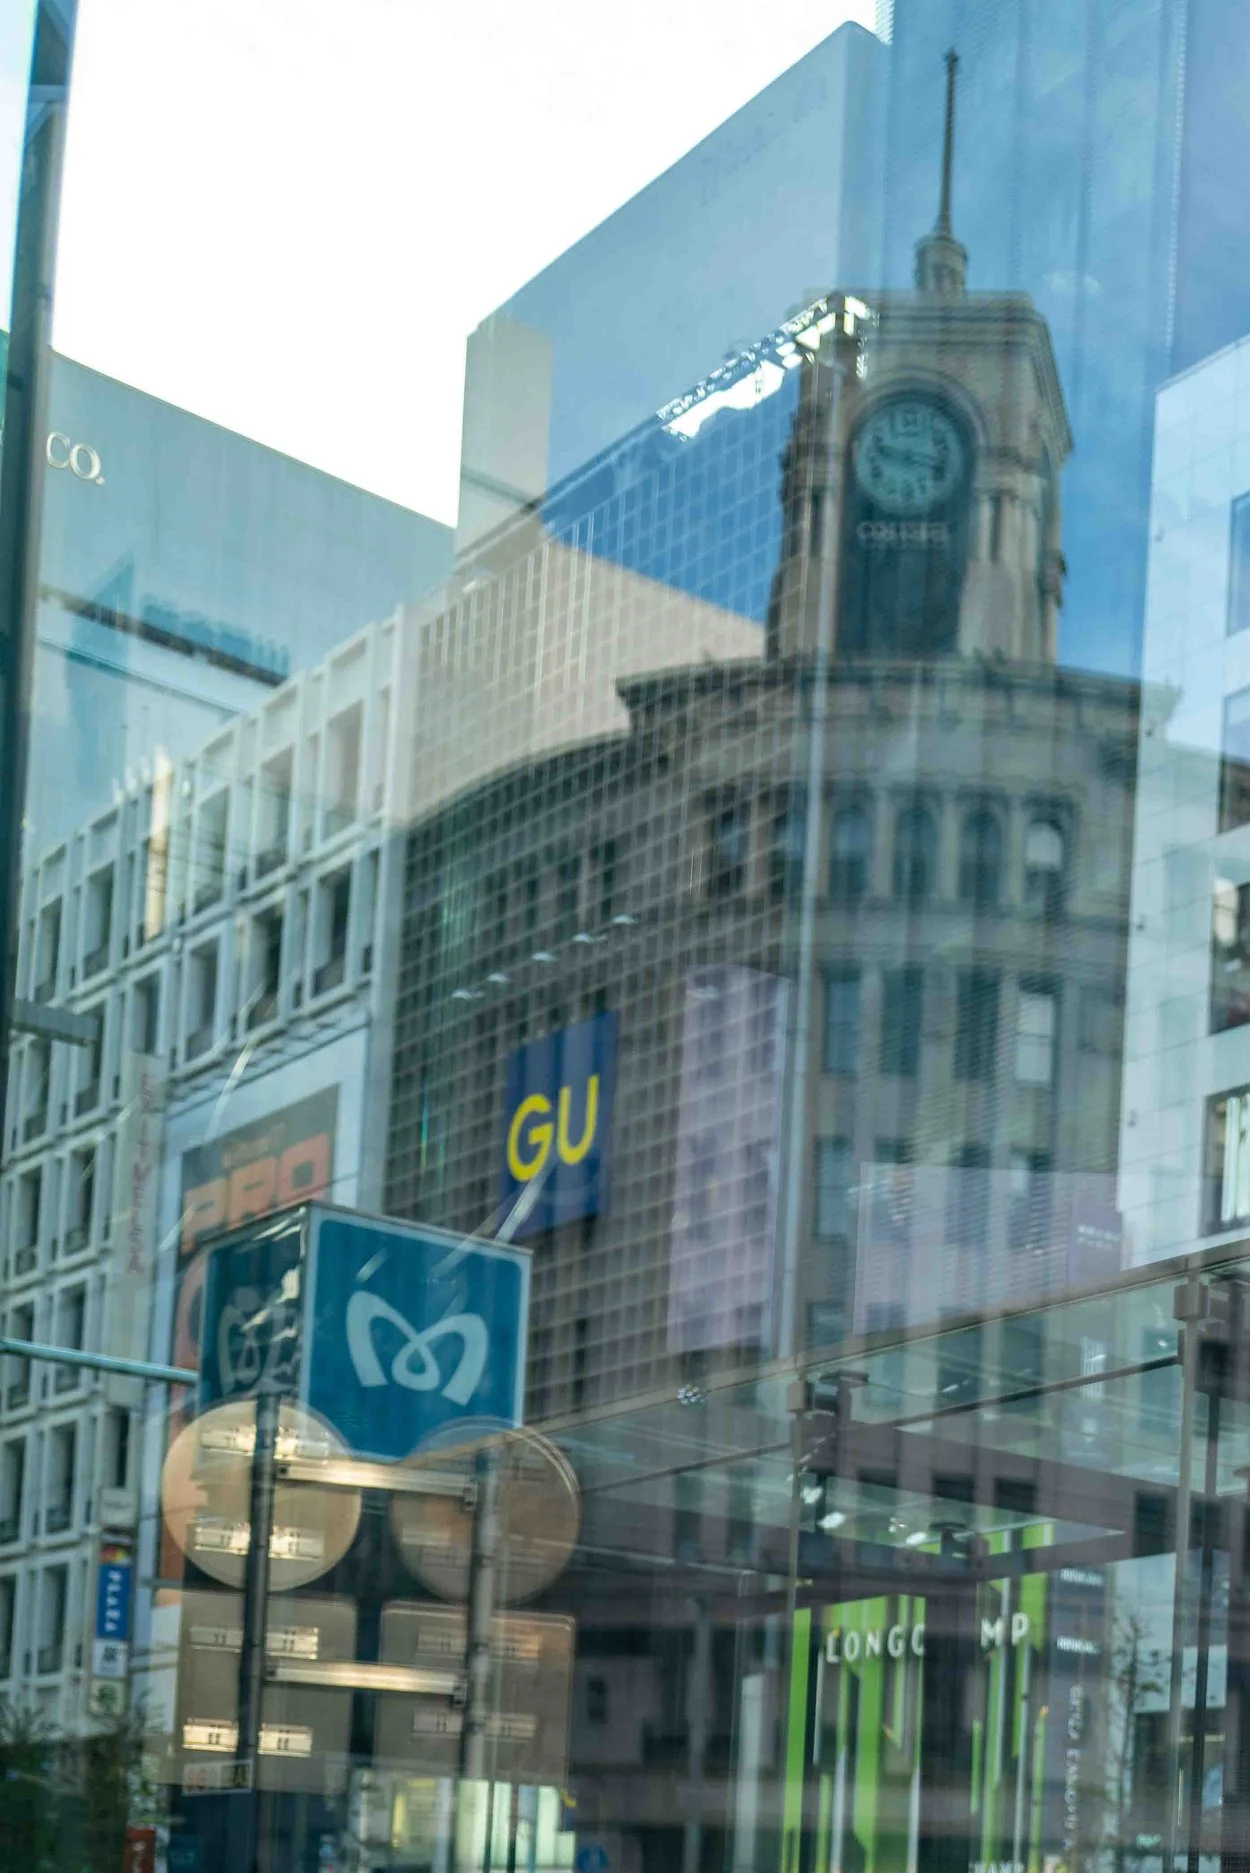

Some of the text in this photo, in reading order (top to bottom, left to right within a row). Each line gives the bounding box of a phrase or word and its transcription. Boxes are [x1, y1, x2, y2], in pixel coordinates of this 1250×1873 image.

[46, 431, 106, 486] CO.
[507, 1073, 599, 1182] GU
[826, 1612, 1030, 1664] LONGCMP
